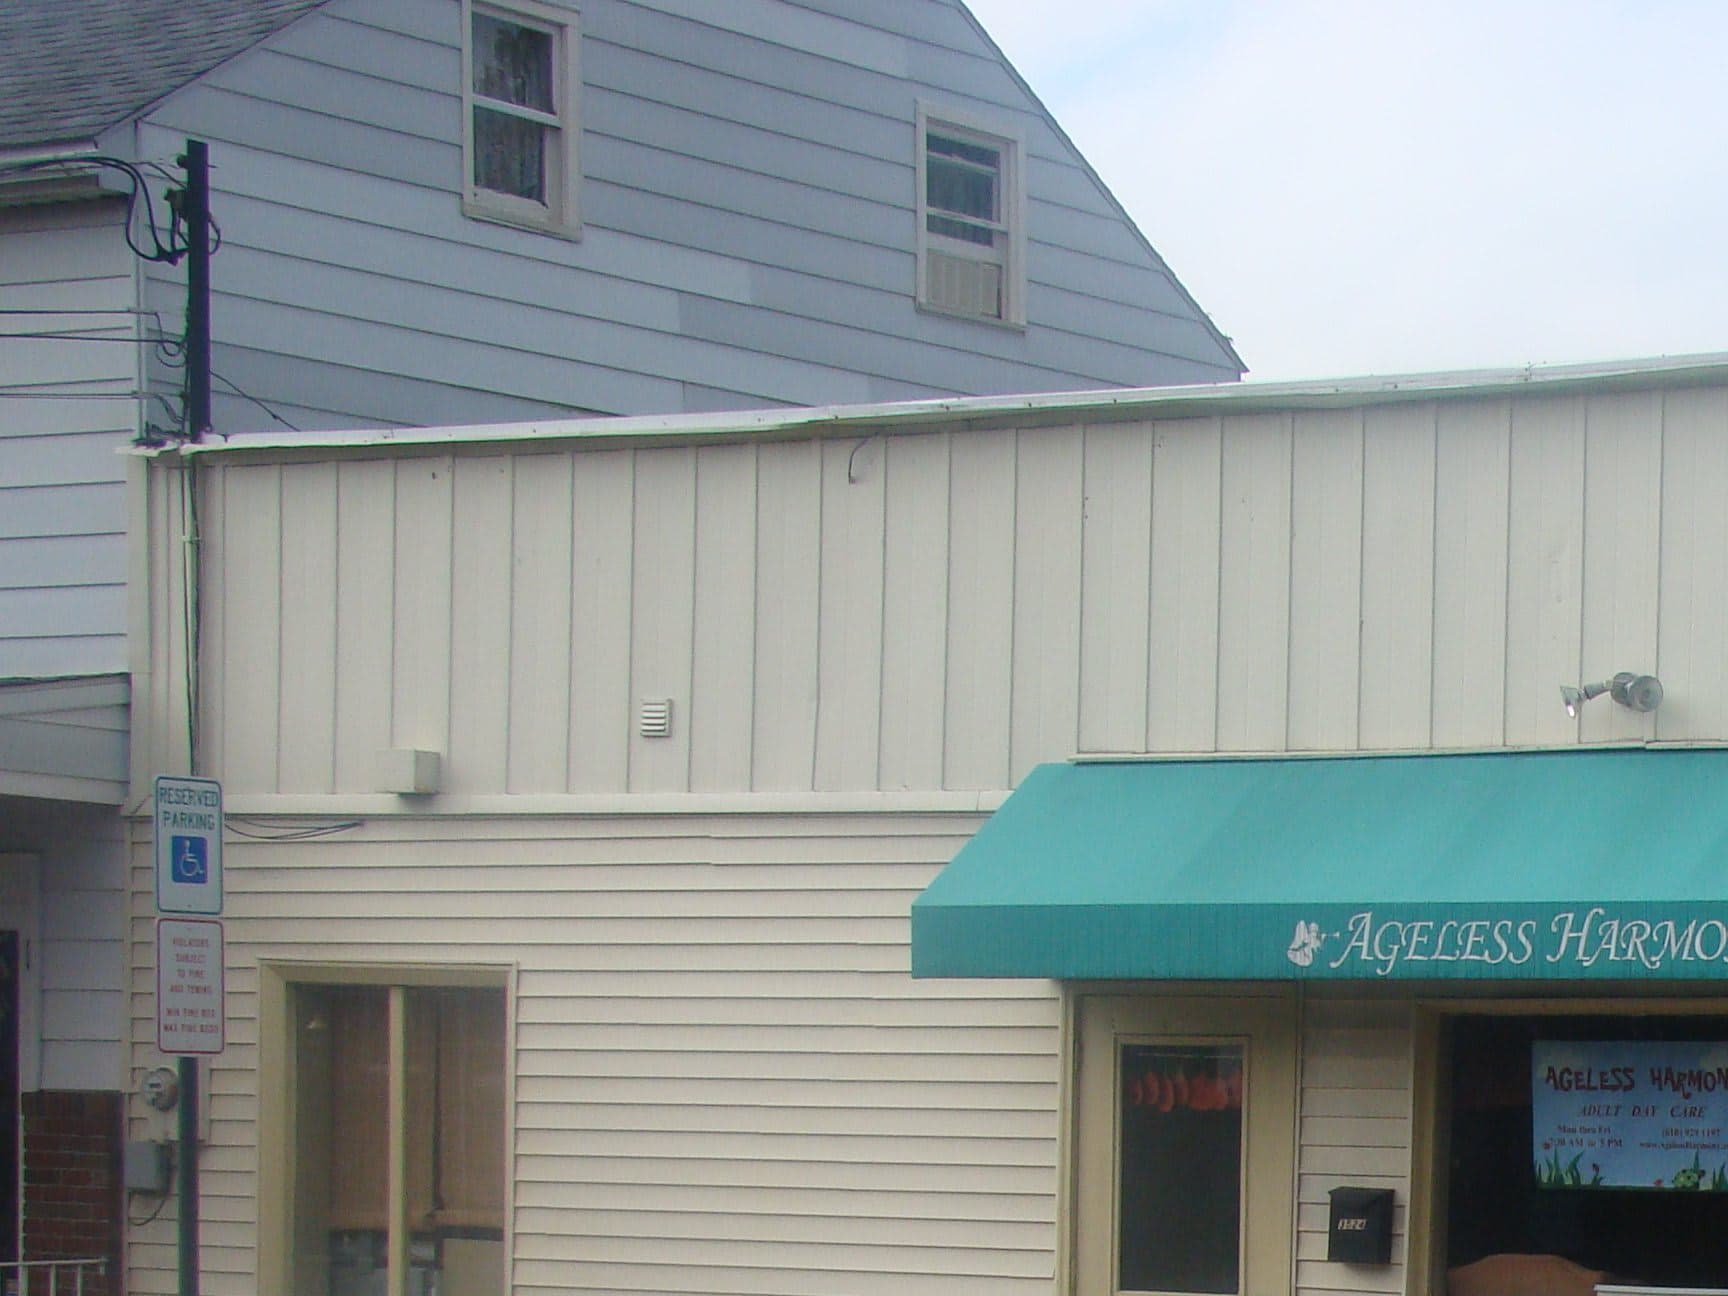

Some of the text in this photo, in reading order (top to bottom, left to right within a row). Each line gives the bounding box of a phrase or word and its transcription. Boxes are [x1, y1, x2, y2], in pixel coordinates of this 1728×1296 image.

[159, 786, 219, 807] RESERVED
[162, 810, 216, 831] PARKING
[1329, 911, 1536, 975] AGELESS
[1545, 1065, 1636, 1092] AGELESS
[1579, 1104, 1708, 1119] ADULT DAY CARE
